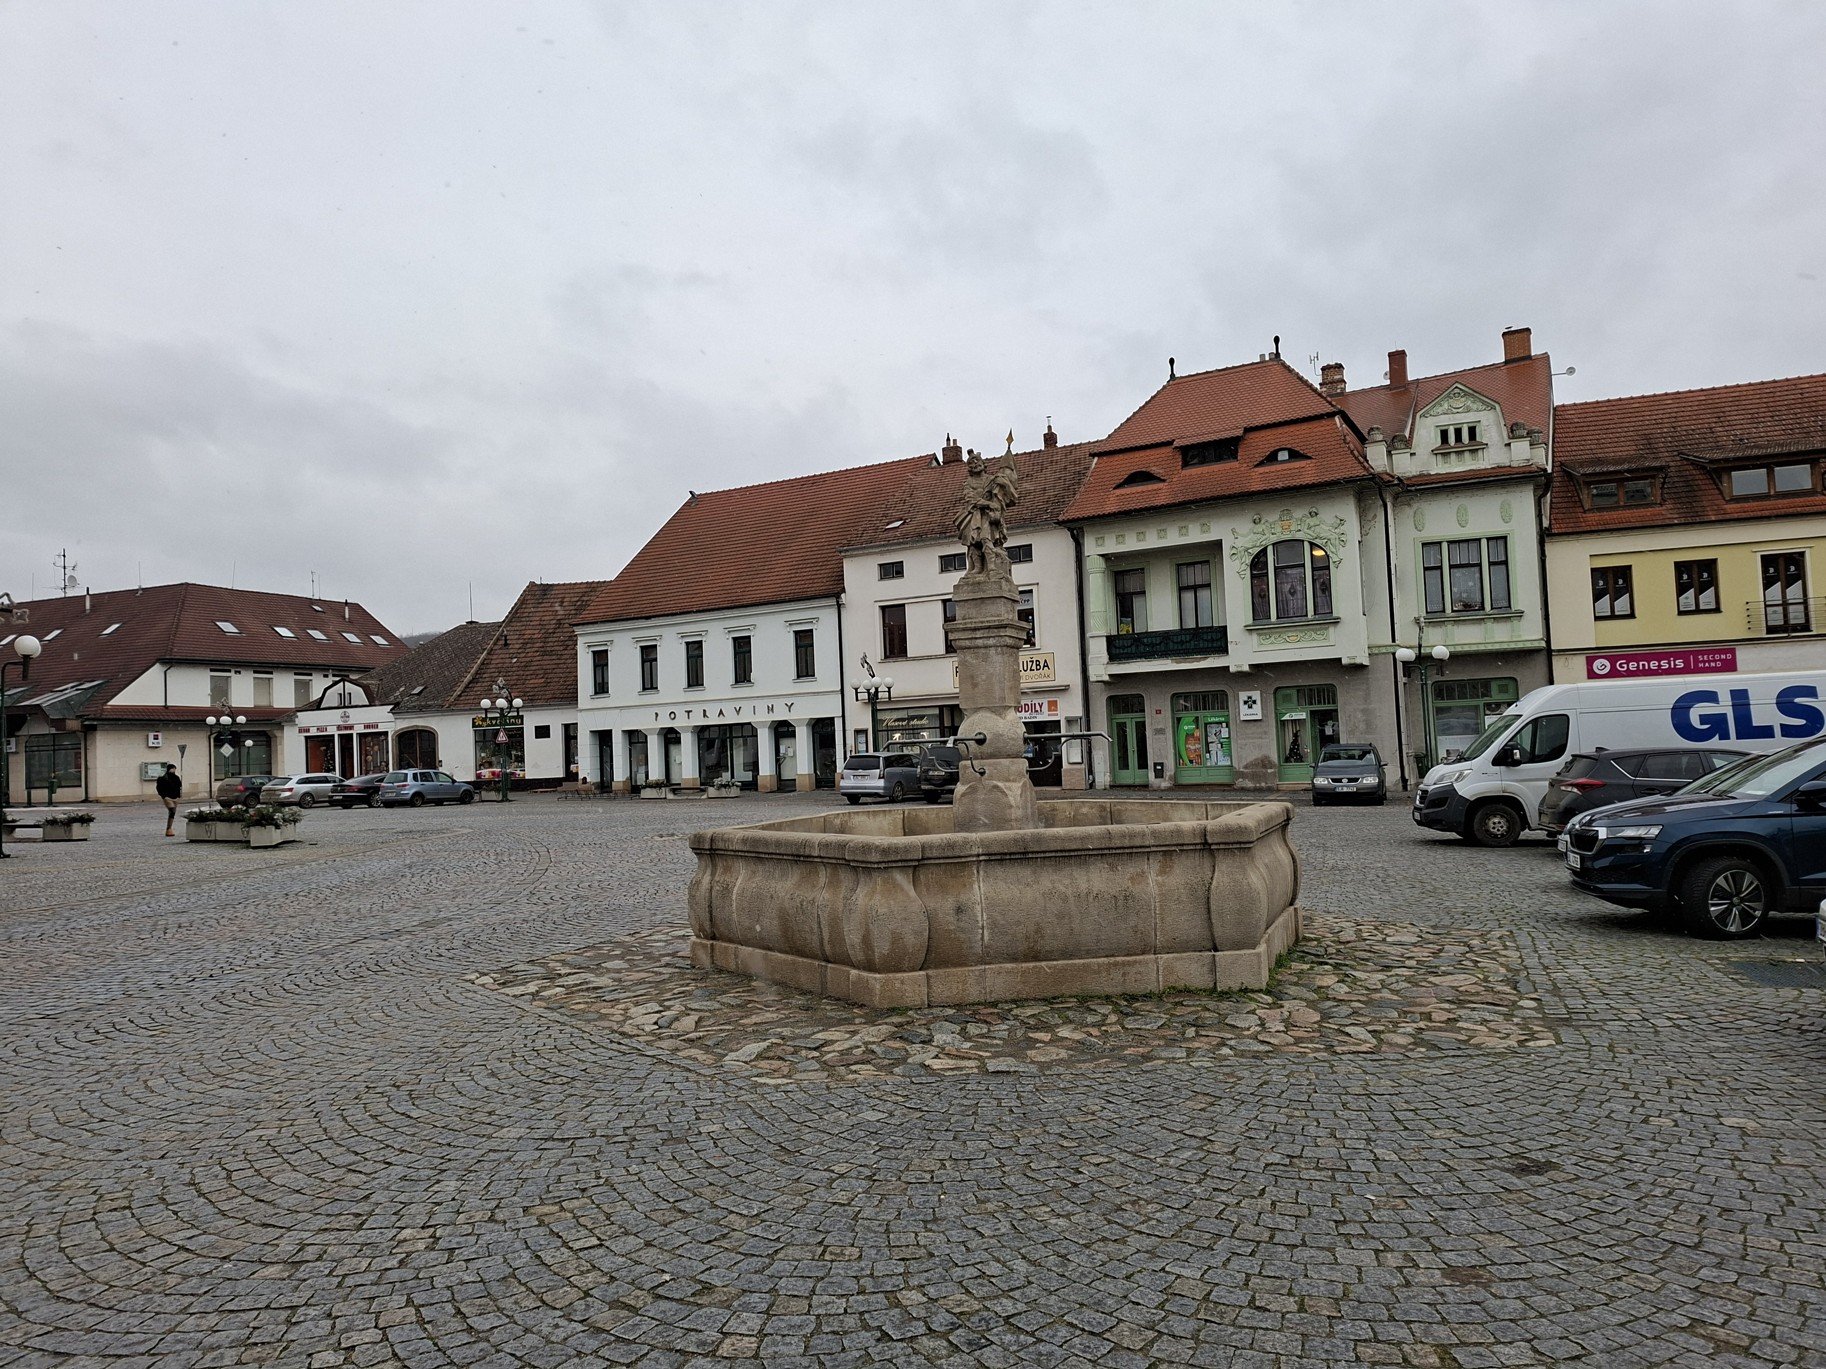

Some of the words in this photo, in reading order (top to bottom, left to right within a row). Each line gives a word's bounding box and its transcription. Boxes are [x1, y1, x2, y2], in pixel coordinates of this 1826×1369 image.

[1020, 657, 1050, 672] UŽBA
[1616, 658, 1684, 671] Genesis
[654, 702, 795, 722] POTRAVINY
[1671, 685, 1825, 742] GLS
